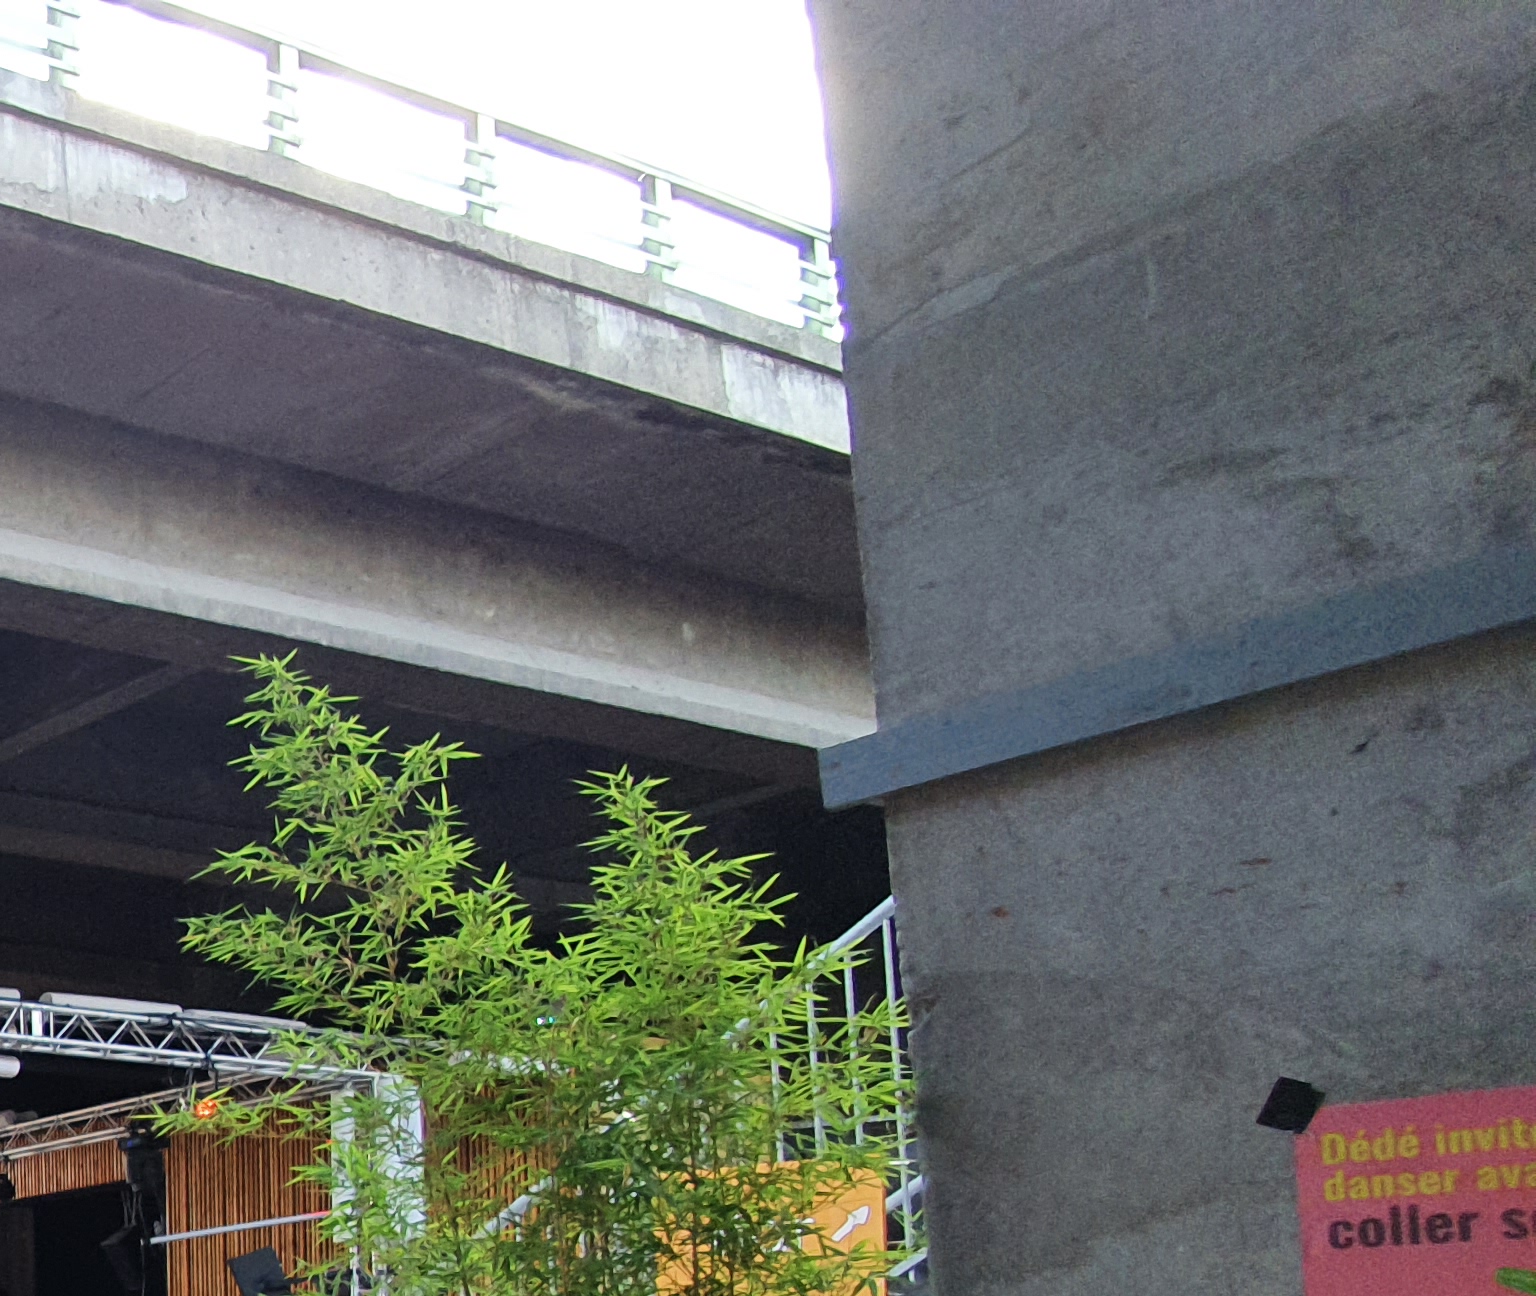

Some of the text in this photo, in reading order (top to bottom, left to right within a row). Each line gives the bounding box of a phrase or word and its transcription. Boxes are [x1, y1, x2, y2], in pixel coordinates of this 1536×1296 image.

[1321, 1117, 1536, 1165] Dédé invit
[1324, 1170, 1460, 1201] danser
[1328, 1204, 1481, 1249] coller
